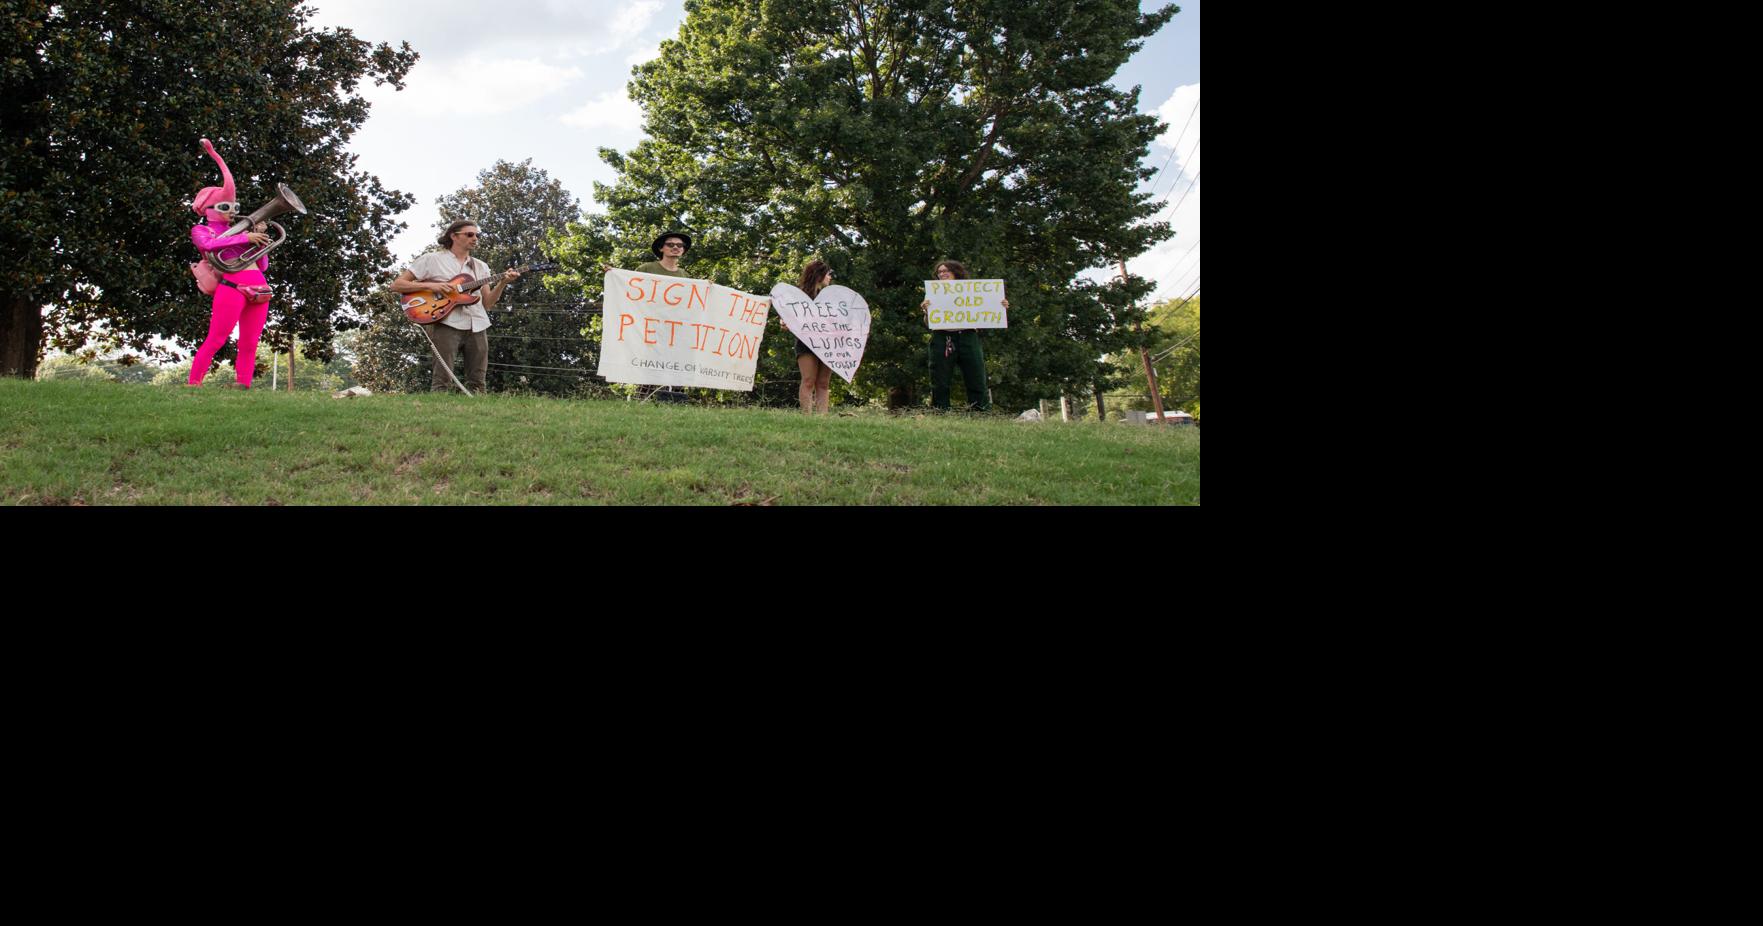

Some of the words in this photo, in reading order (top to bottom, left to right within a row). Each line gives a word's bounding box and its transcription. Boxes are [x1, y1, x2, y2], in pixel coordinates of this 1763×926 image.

[931, 281, 1002, 294] PROTECT
[626, 277, 709, 310] SIGN
[728, 293, 767, 326] THE
[954, 296, 983, 307] OLD
[786, 301, 849, 318] TREES
[929, 309, 1002, 325] GROWTH
[801, 322, 829, 333] ARE
[832, 322, 852, 332] THE
[617, 313, 759, 361] PETITION
[809, 336, 862, 350] LUNGS
